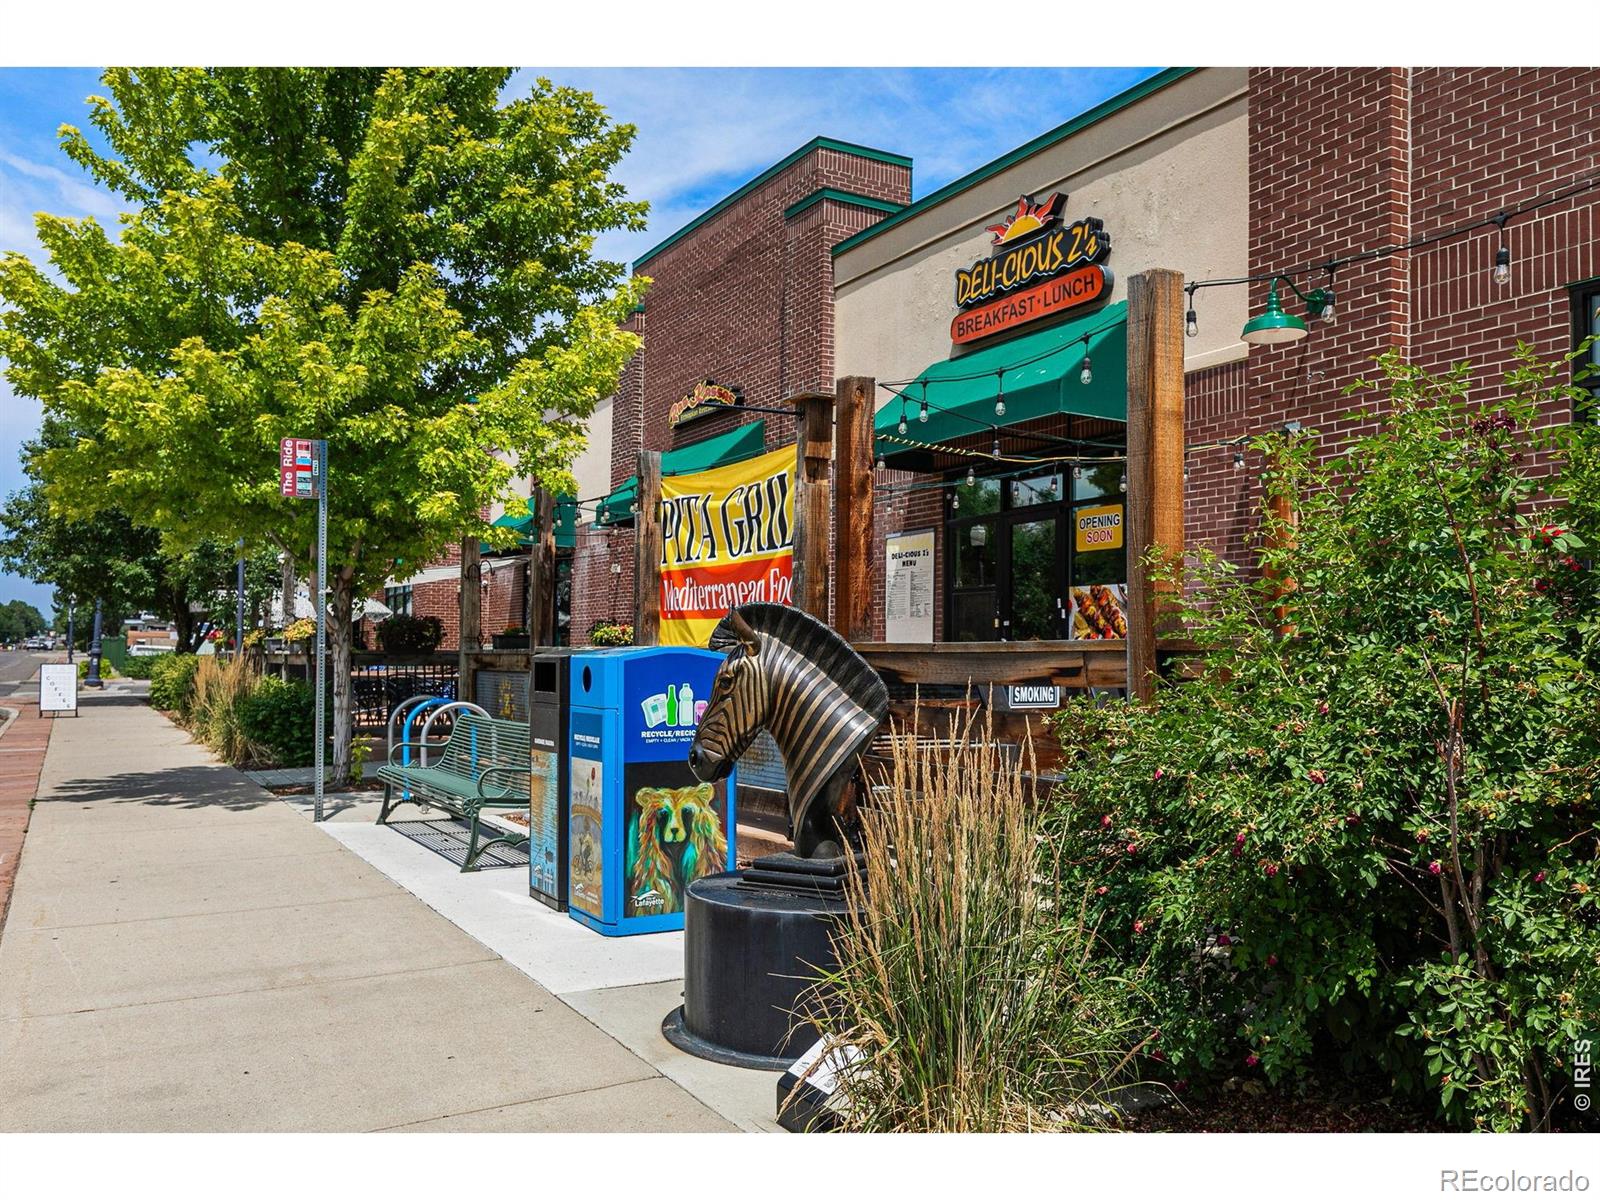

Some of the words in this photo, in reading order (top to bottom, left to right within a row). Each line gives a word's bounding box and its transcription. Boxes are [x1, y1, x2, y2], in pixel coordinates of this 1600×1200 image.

[957, 231, 1064, 305] DELI-CIOUS
[957, 295, 1036, 338] BREAKFAST
[1043, 273, 1095, 308] LUNCH
[283, 440, 293, 467] Ride
[283, 471, 293, 494] The
[661, 494, 717, 565] PITA
[1079, 513, 1120, 530] OPENING
[1086, 530, 1112, 543] SOON
[663, 576, 766, 612] Mediterranean
[1014, 686, 1054, 702] SMOKING
[634, 898, 665, 908] Lafayette
